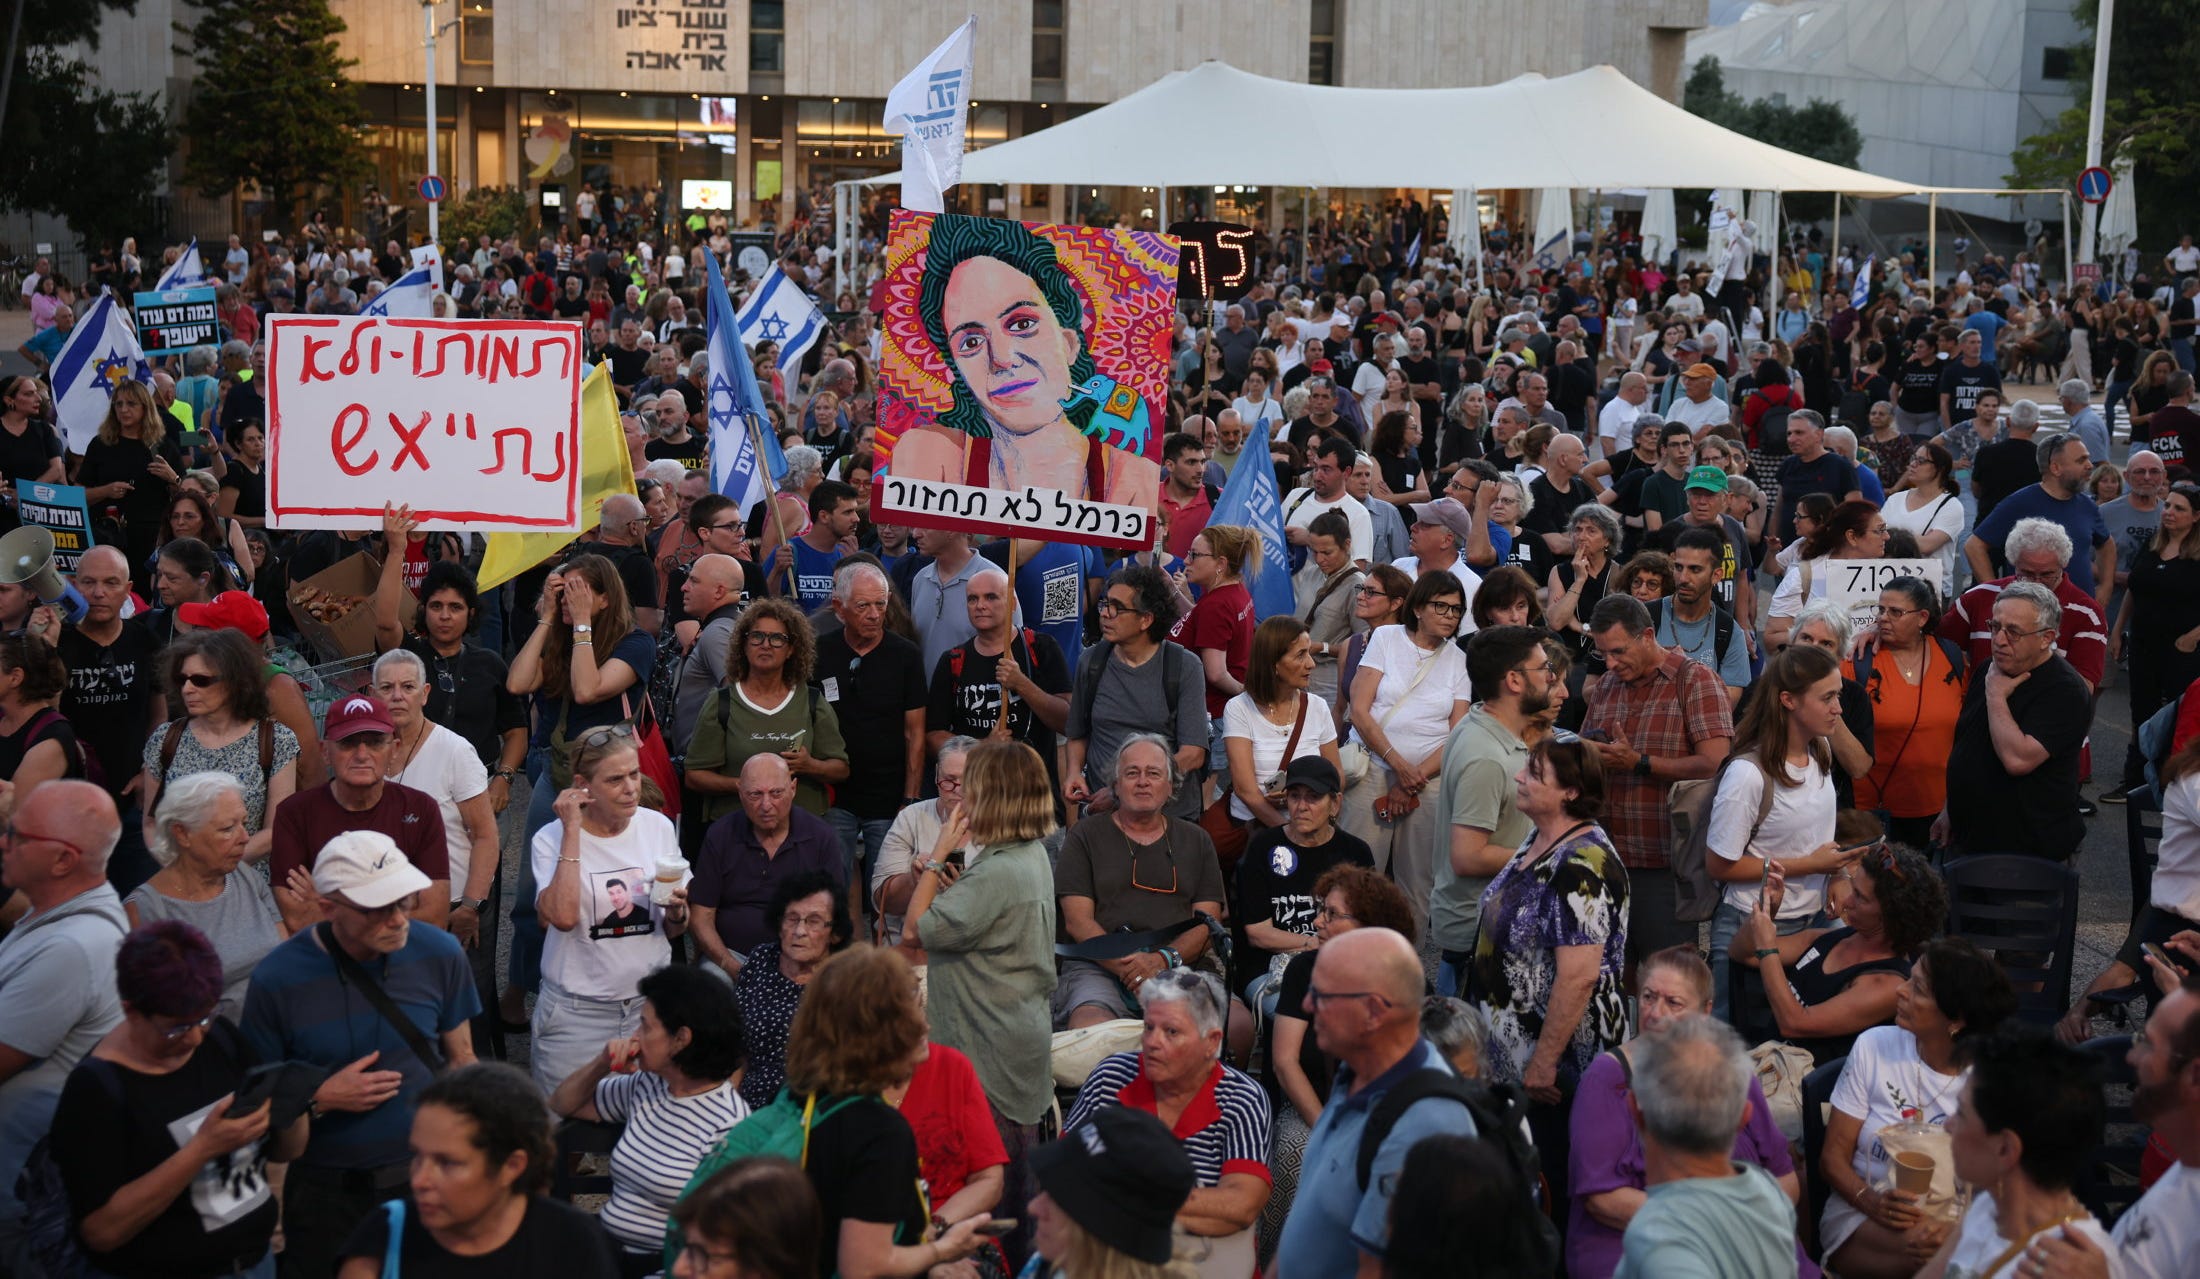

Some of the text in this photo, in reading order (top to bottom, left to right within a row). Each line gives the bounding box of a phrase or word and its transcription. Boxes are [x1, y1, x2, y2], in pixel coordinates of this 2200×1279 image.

[682, 32, 727, 50] בית
[627, 51, 726, 71] אריאלה
[139, 304, 214, 325] כמה דם עוד
[149, 325, 211, 348] יישפך?
[2152, 436, 2182, 451] FCK
[889, 481, 987, 516] תחזור
[1000, 488, 1042, 522] לא
[21, 502, 83, 526] ועדת חקירה
[2126, 525, 2160, 536] oasi
[799, 579, 833, 590] קרטים
[75, 692, 128, 705] באוקטובר
[966, 713, 1018, 729] בקטובר
